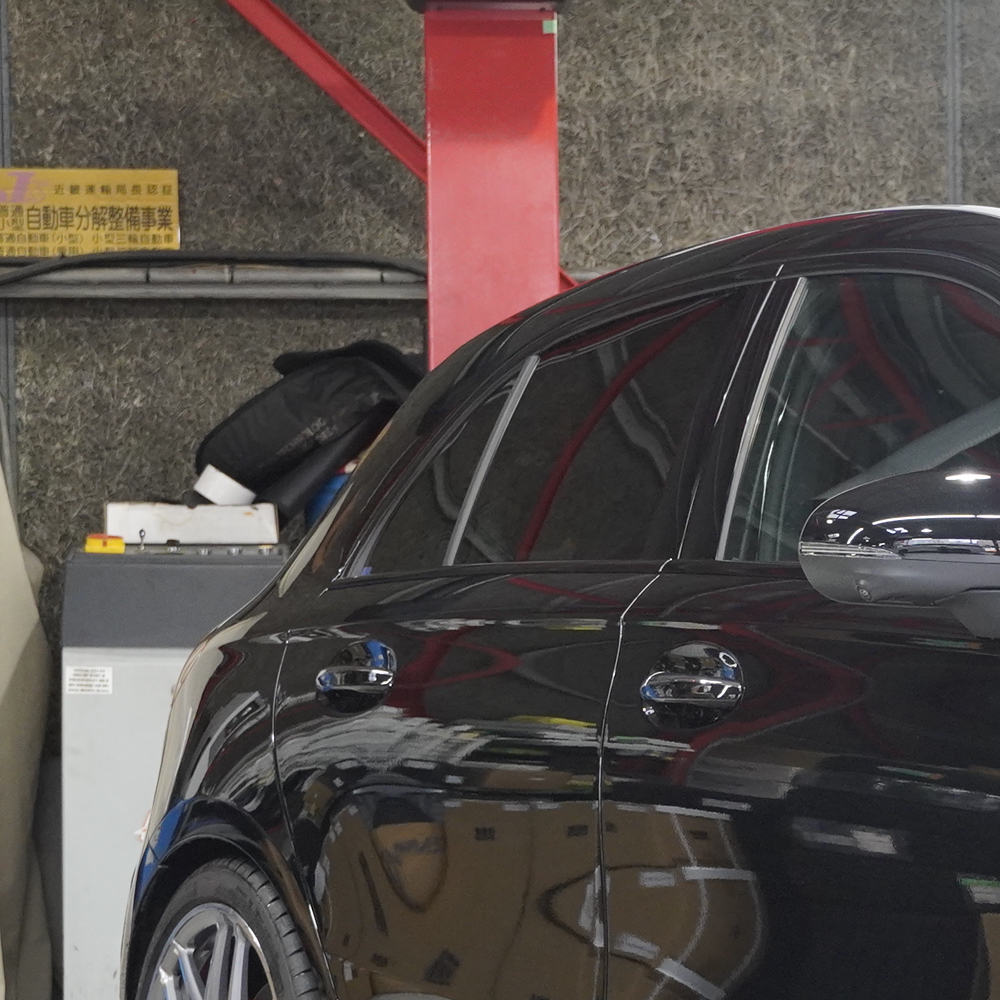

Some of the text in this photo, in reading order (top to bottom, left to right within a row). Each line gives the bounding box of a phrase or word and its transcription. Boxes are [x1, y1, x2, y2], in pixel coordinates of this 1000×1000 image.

[26, 205, 174, 231] 自動車分解整備事業
